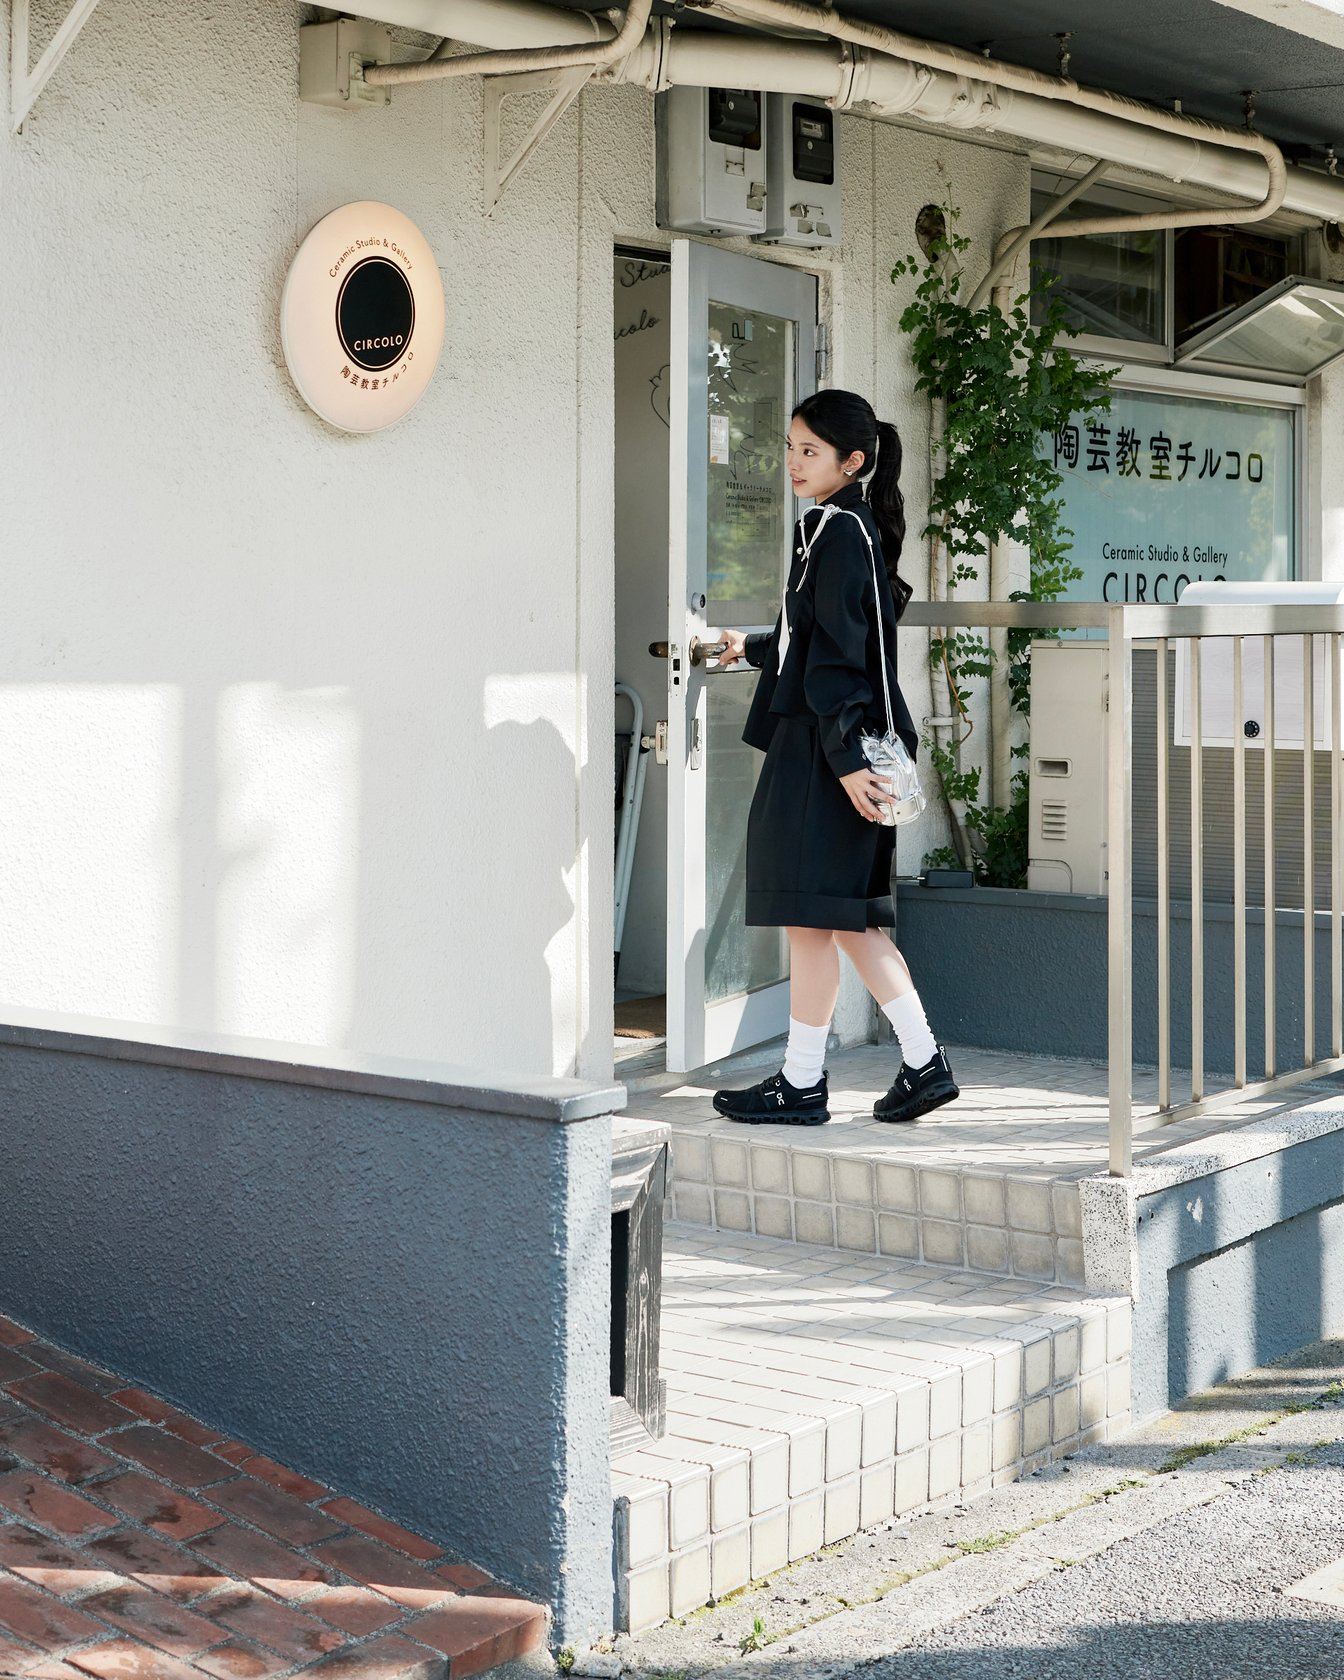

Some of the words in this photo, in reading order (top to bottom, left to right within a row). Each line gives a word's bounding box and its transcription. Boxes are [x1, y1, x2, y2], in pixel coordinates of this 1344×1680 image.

[328, 246, 356, 278] Ceramic
[355, 236, 381, 249] Studio
[382, 238, 389, 248] &
[391, 242, 413, 270] Gallery
[353, 334, 403, 351] CIRCOLO
[340, 351, 414, 391] 陶芸教室チルコロ
[1053, 422, 1264, 484] 陶芸教室チルコロ
[1102, 542, 1145, 561] Ceramic
[1148, 543, 1179, 563] Studio
[1182, 547, 1190, 563] &
[1193, 545, 1228, 569] Gallery
[1102, 571, 1228, 603] CIRCO
